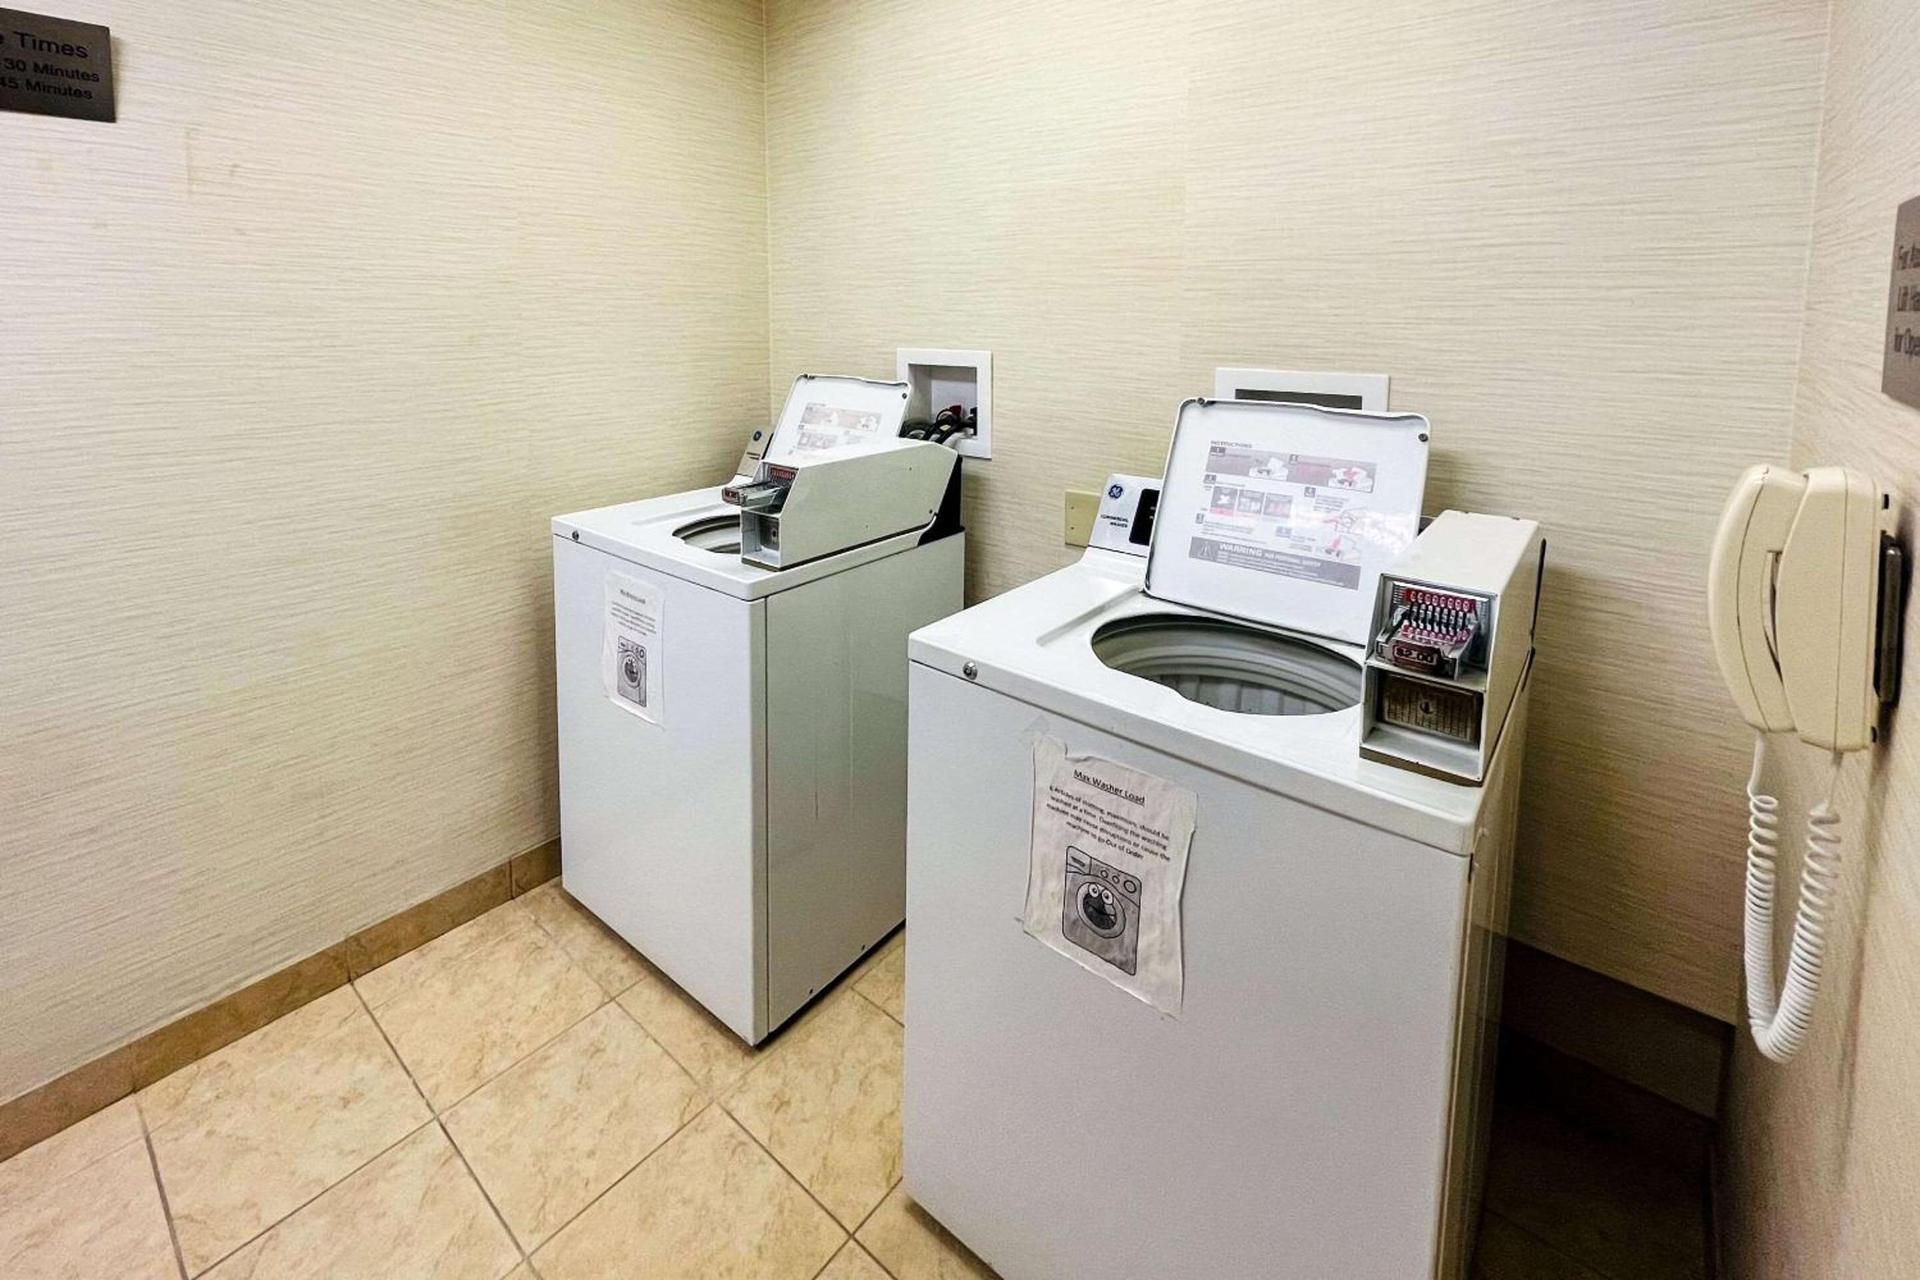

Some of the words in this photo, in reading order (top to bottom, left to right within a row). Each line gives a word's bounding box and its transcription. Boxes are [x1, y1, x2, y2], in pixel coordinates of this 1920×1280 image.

[12, 31, 89, 59] Times
[4, 58, 26, 73] 30
[33, 62, 100, 82] Minutes
[26, 80, 94, 100] Minutes
[1219, 543, 1263, 558] WARNING
[1073, 769, 1090, 782] Max
[1092, 776, 1122, 795] Washer
[1124, 790, 1145, 805] Load
